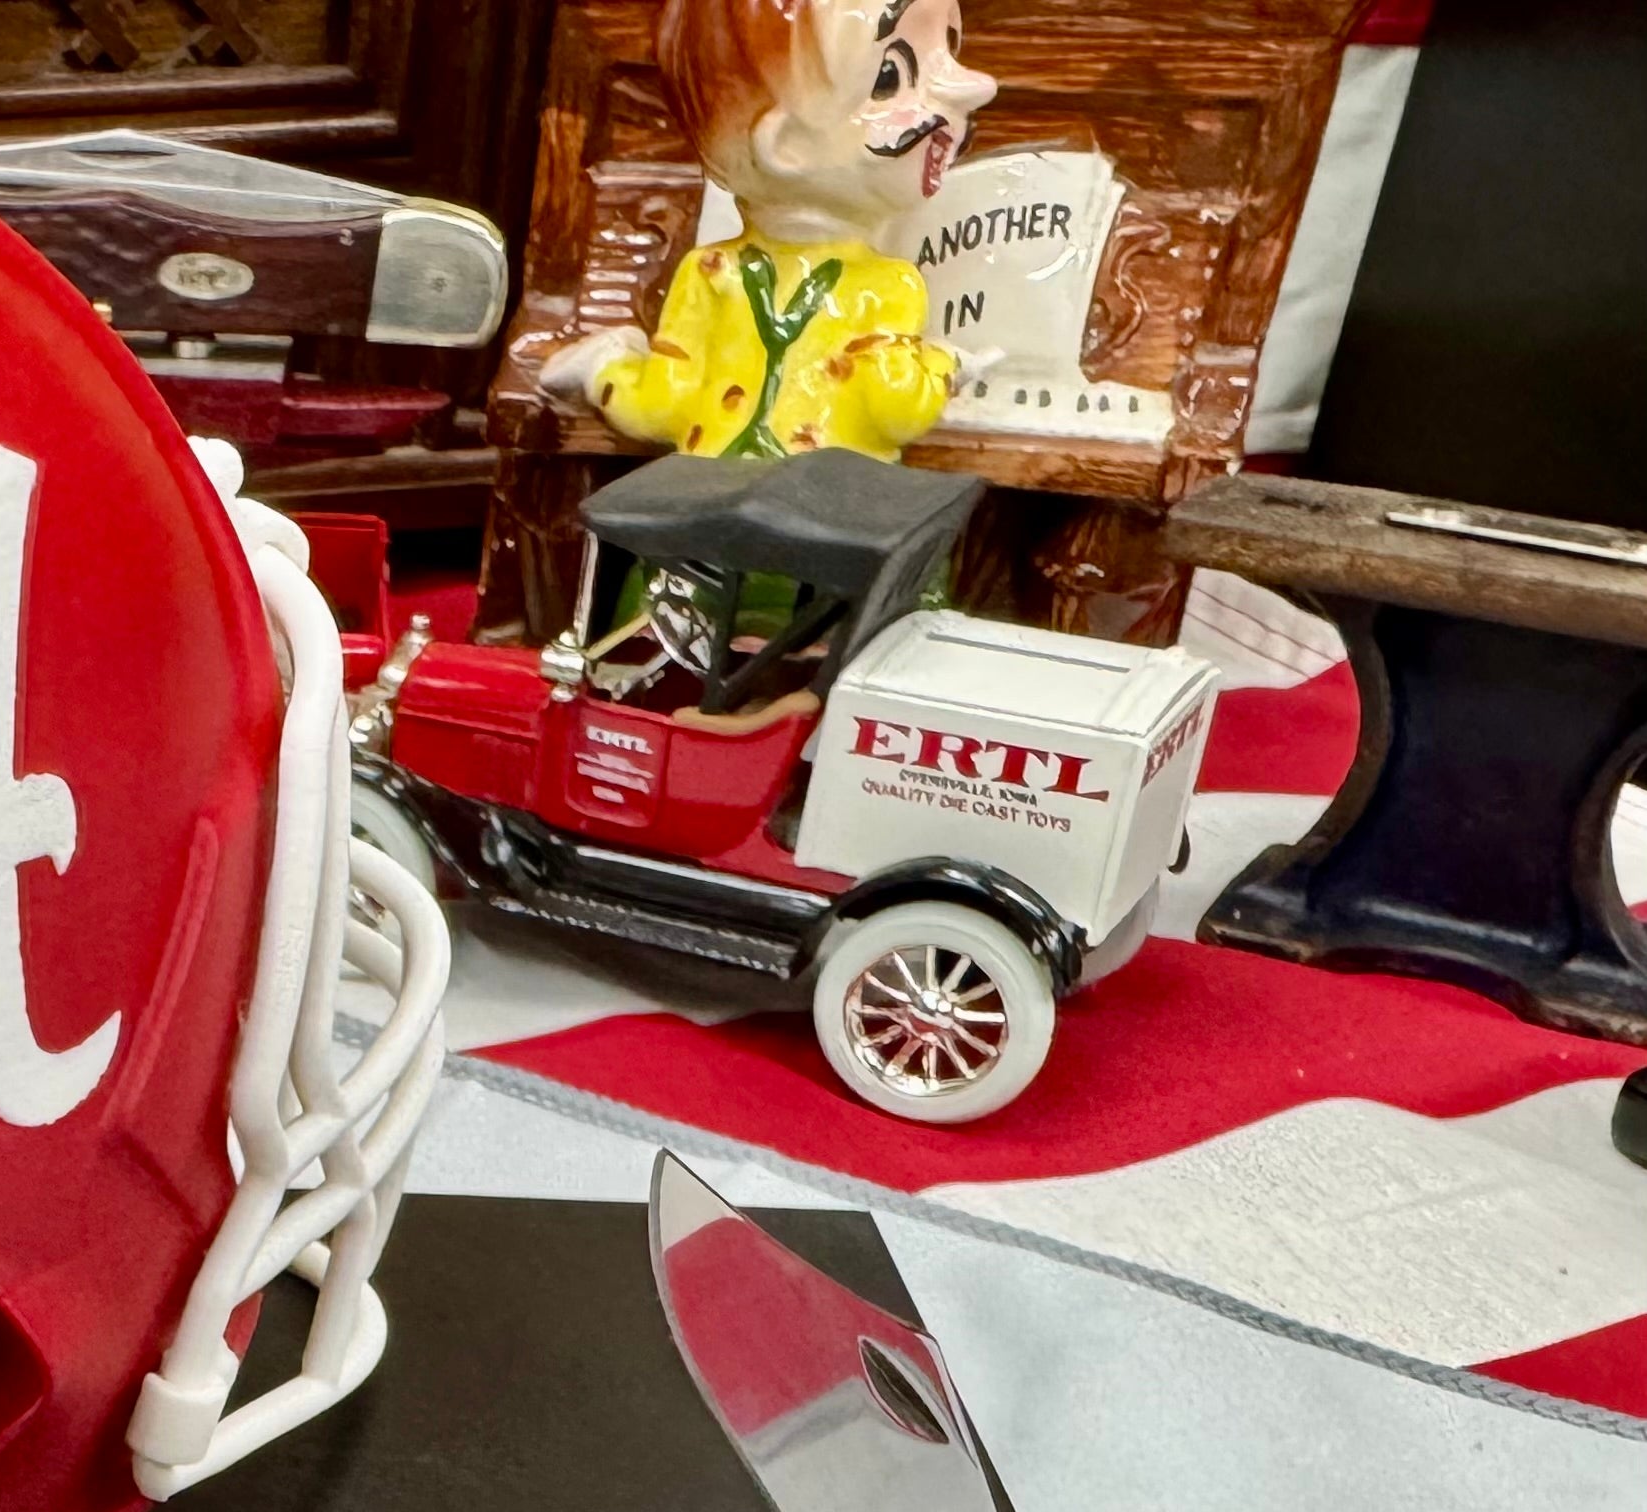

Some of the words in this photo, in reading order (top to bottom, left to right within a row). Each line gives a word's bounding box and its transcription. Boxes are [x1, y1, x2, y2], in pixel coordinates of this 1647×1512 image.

[916, 202, 1073, 267] ANOTHER
[944, 291, 985, 335] IN
[849, 716, 1111, 802] ERTL
[971, 799, 1020, 822] CAST
[1025, 810, 1072, 833] TOYS
